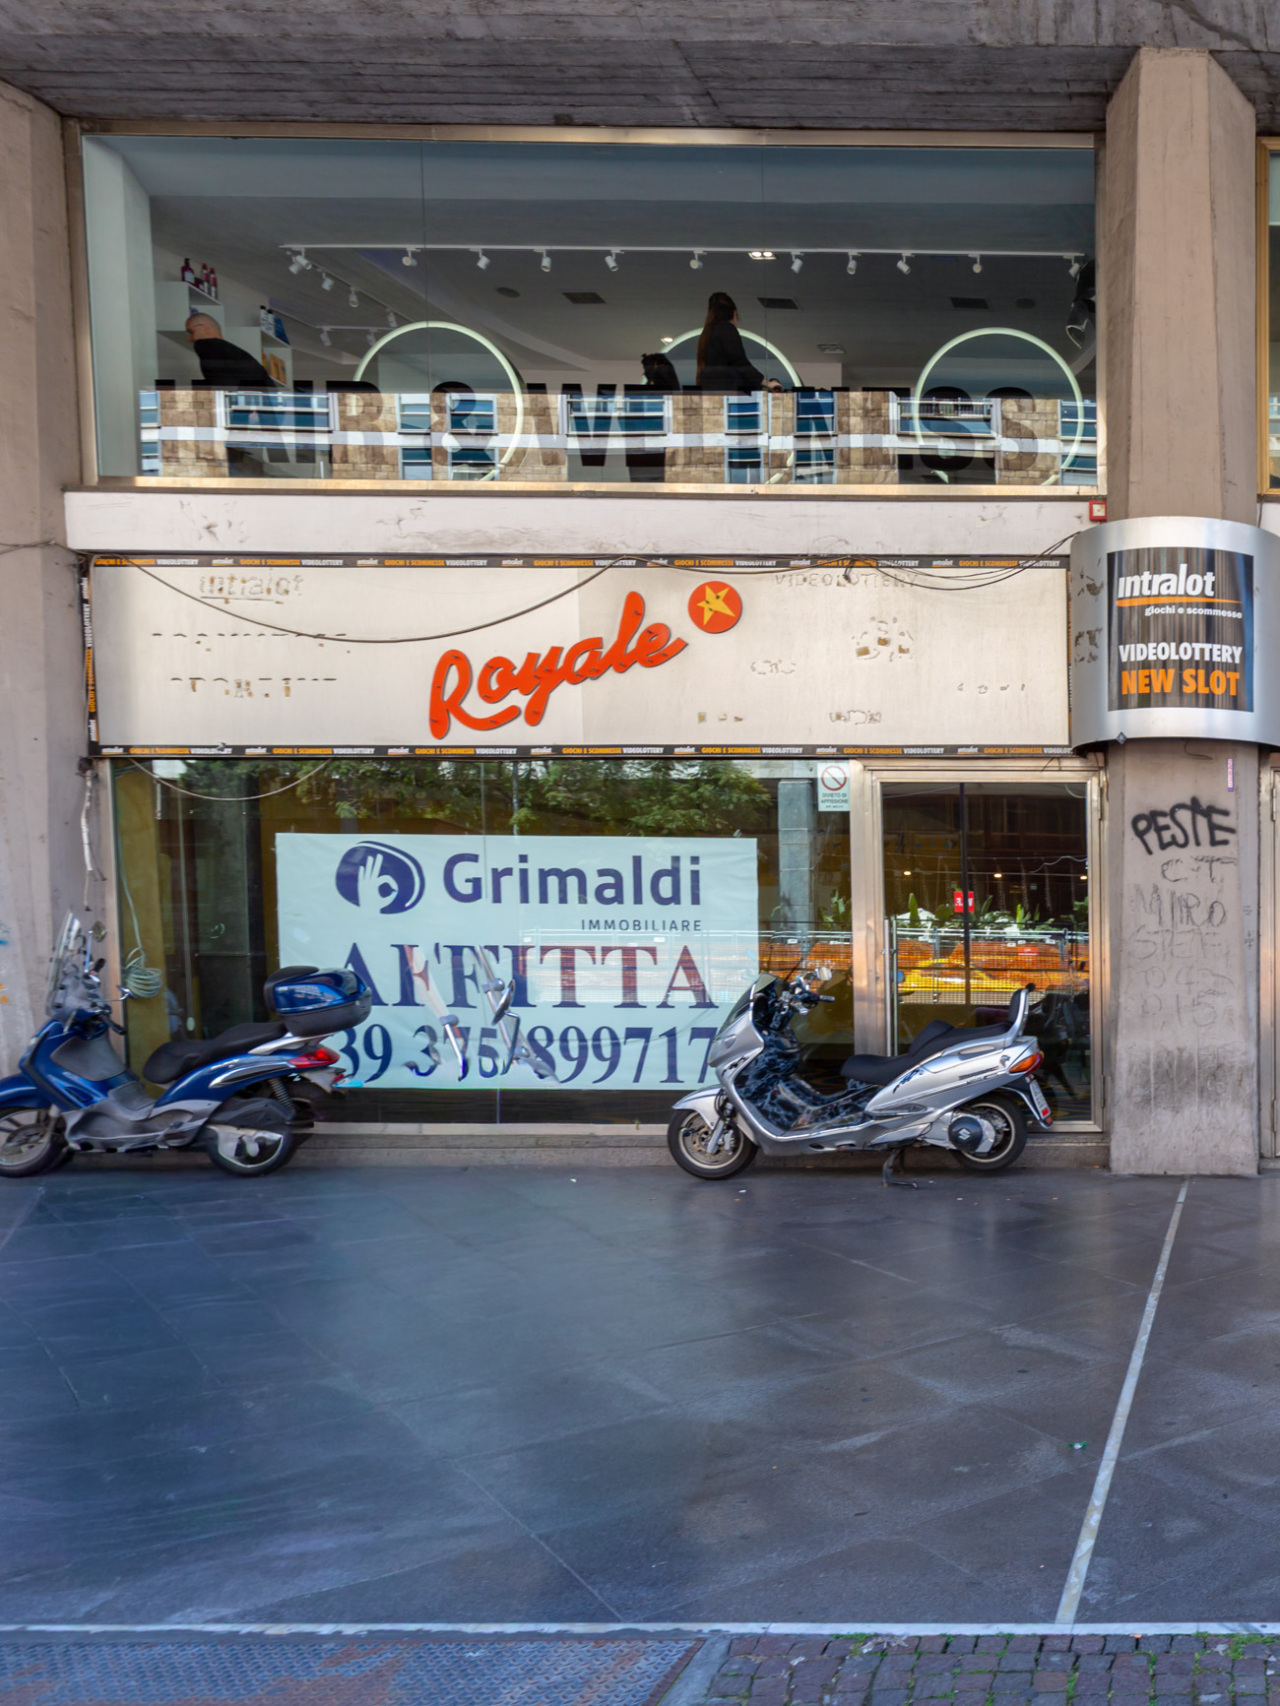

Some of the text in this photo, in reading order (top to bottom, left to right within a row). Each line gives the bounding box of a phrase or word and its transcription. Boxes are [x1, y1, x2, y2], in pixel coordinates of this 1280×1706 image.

[1118, 563, 1215, 597] intralot
[1186, 607, 1243, 619] scommesse
[429, 591, 688, 740] Royale
[1119, 642, 1243, 664] VIDEOLOTTERY
[1121, 668, 1240, 696] NEW SLOT
[1131, 796, 1236, 855] PESTE
[444, 852, 701, 907] Grimaldi
[581, 919, 702, 932] IMMOBILIARE
